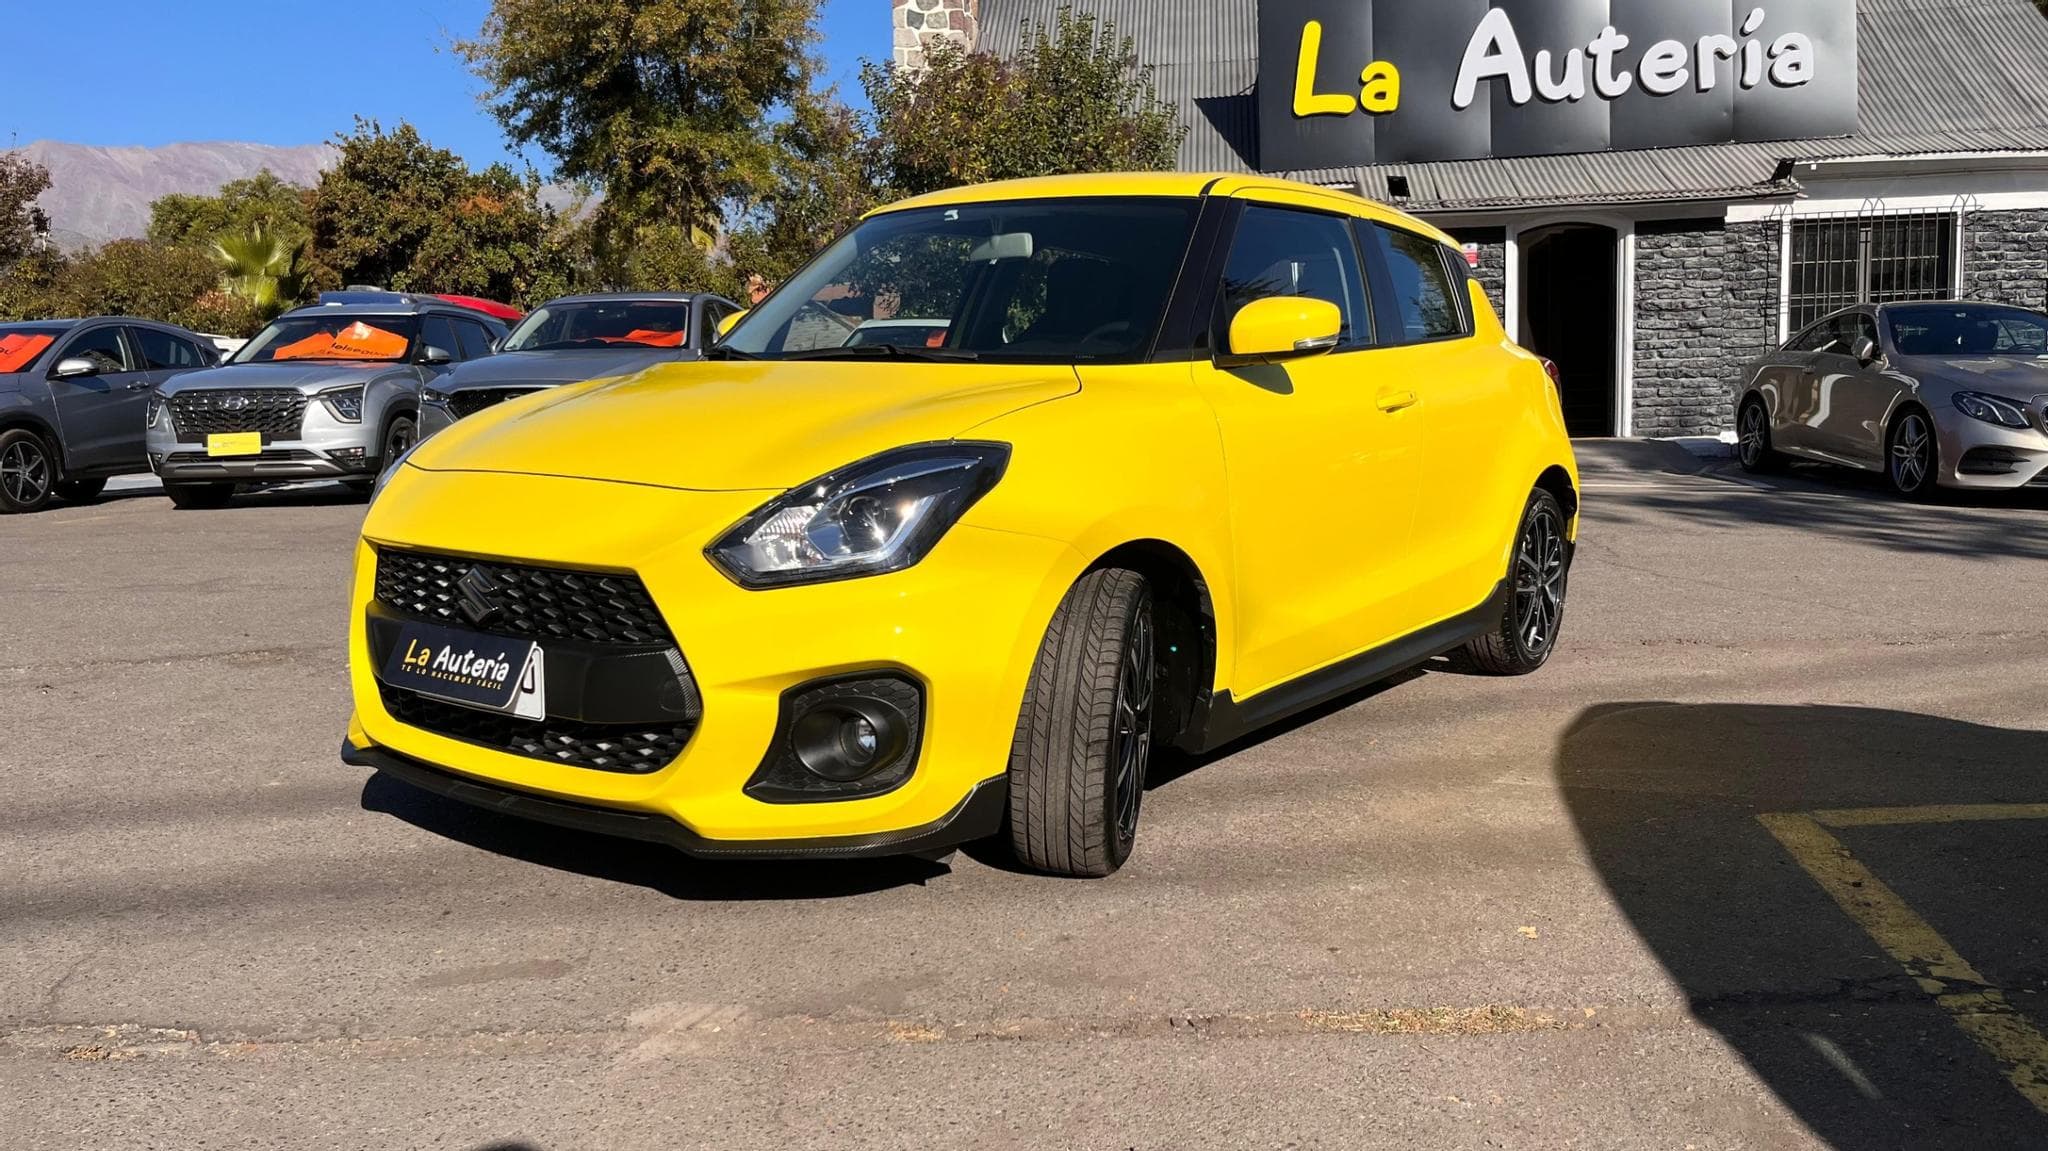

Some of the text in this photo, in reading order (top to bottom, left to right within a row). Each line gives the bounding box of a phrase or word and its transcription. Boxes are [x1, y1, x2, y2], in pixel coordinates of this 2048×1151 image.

[1292, 7, 1815, 118] La Autería
[401, 664, 411, 672] TE
[431, 671, 472, 685] HACEMOS
[404, 638, 431, 667] La
[432, 645, 510, 682] Autería
